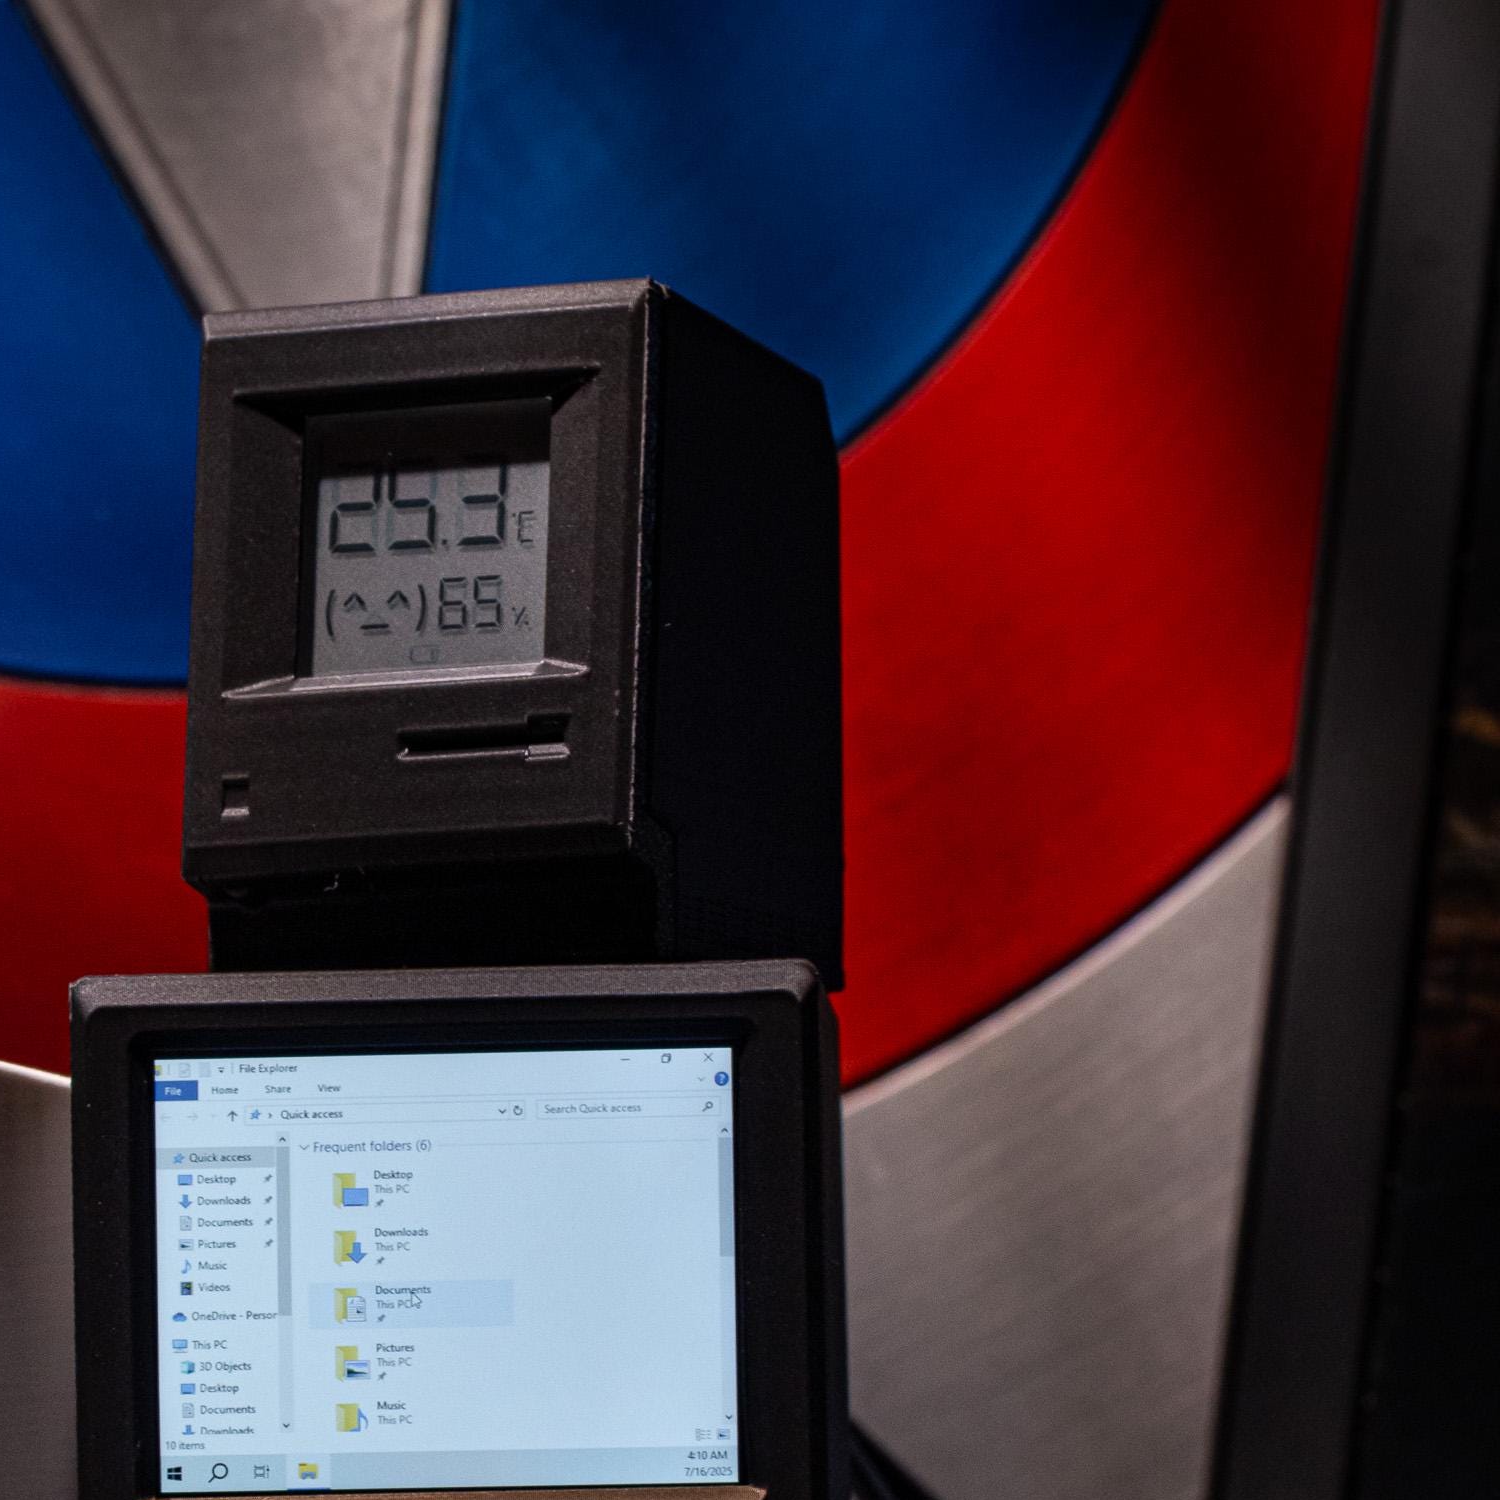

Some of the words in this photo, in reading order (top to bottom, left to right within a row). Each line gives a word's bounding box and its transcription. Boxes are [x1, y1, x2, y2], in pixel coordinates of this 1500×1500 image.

[439, 575, 501, 629] 65
[239, 1063, 255, 1074] File
[258, 1062, 298, 1076] Explorer
[164, 1086, 182, 1096] File
[211, 1085, 239, 1095] Home
[264, 1084, 292, 1094] Share
[317, 1083, 340, 1093] View
[280, 1109, 309, 1120] Quick
[312, 1110, 343, 1119] access
[544, 1104, 576, 1114] Search
[580, 1103, 605, 1115] Quick
[608, 1104, 641, 1113] access
[312, 1141, 366, 1155] Frequent
[370, 1140, 412, 1152] folders
[416, 1139, 432, 1153] (6)
[189, 1153, 217, 1163] Quick
[218, 1153, 252, 1162] access
[197, 1174, 237, 1186] Desktop
[373, 1169, 414, 1182] Desktop
[374, 1184, 393, 1194] This
[396, 1184, 410, 1193] PC
[197, 1196, 251, 1206] Downloads
[198, 1217, 253, 1228] Documents
[374, 1227, 429, 1238] Downloads
[198, 1238, 237, 1249] Pictures
[374, 1242, 394, 1252] This
[397, 1241, 411, 1251] PC
[198, 1260, 228, 1271] Music
[198, 1281, 231, 1292] Videos
[376, 1286, 431, 1295] Documents
[376, 1300, 394, 1309] This
[192, 1312, 237, 1321] OneDrive
[192, 1339, 210, 1350] This
[213, 1339, 228, 1350] PC
[375, 1342, 416, 1353] Pictures
[200, 1361, 213, 1371] 3D
[216, 1360, 251, 1373] Objects
[376, 1357, 395, 1368] This
[397, 1357, 412, 1367] PC
[200, 1383, 239, 1395] Desktop
[200, 1404, 257, 1415] Documents
[377, 1400, 407, 1411] Music
[377, 1415, 396, 1425] This
[398, 1415, 413, 1425] PC
[165, 1440, 177, 1450] 10
[179, 1440, 205, 1450] items
[687, 1450, 708, 1460] 4:10
[710, 1450, 728, 1460] AM
[685, 1466, 732, 1476] 7/16/2025
